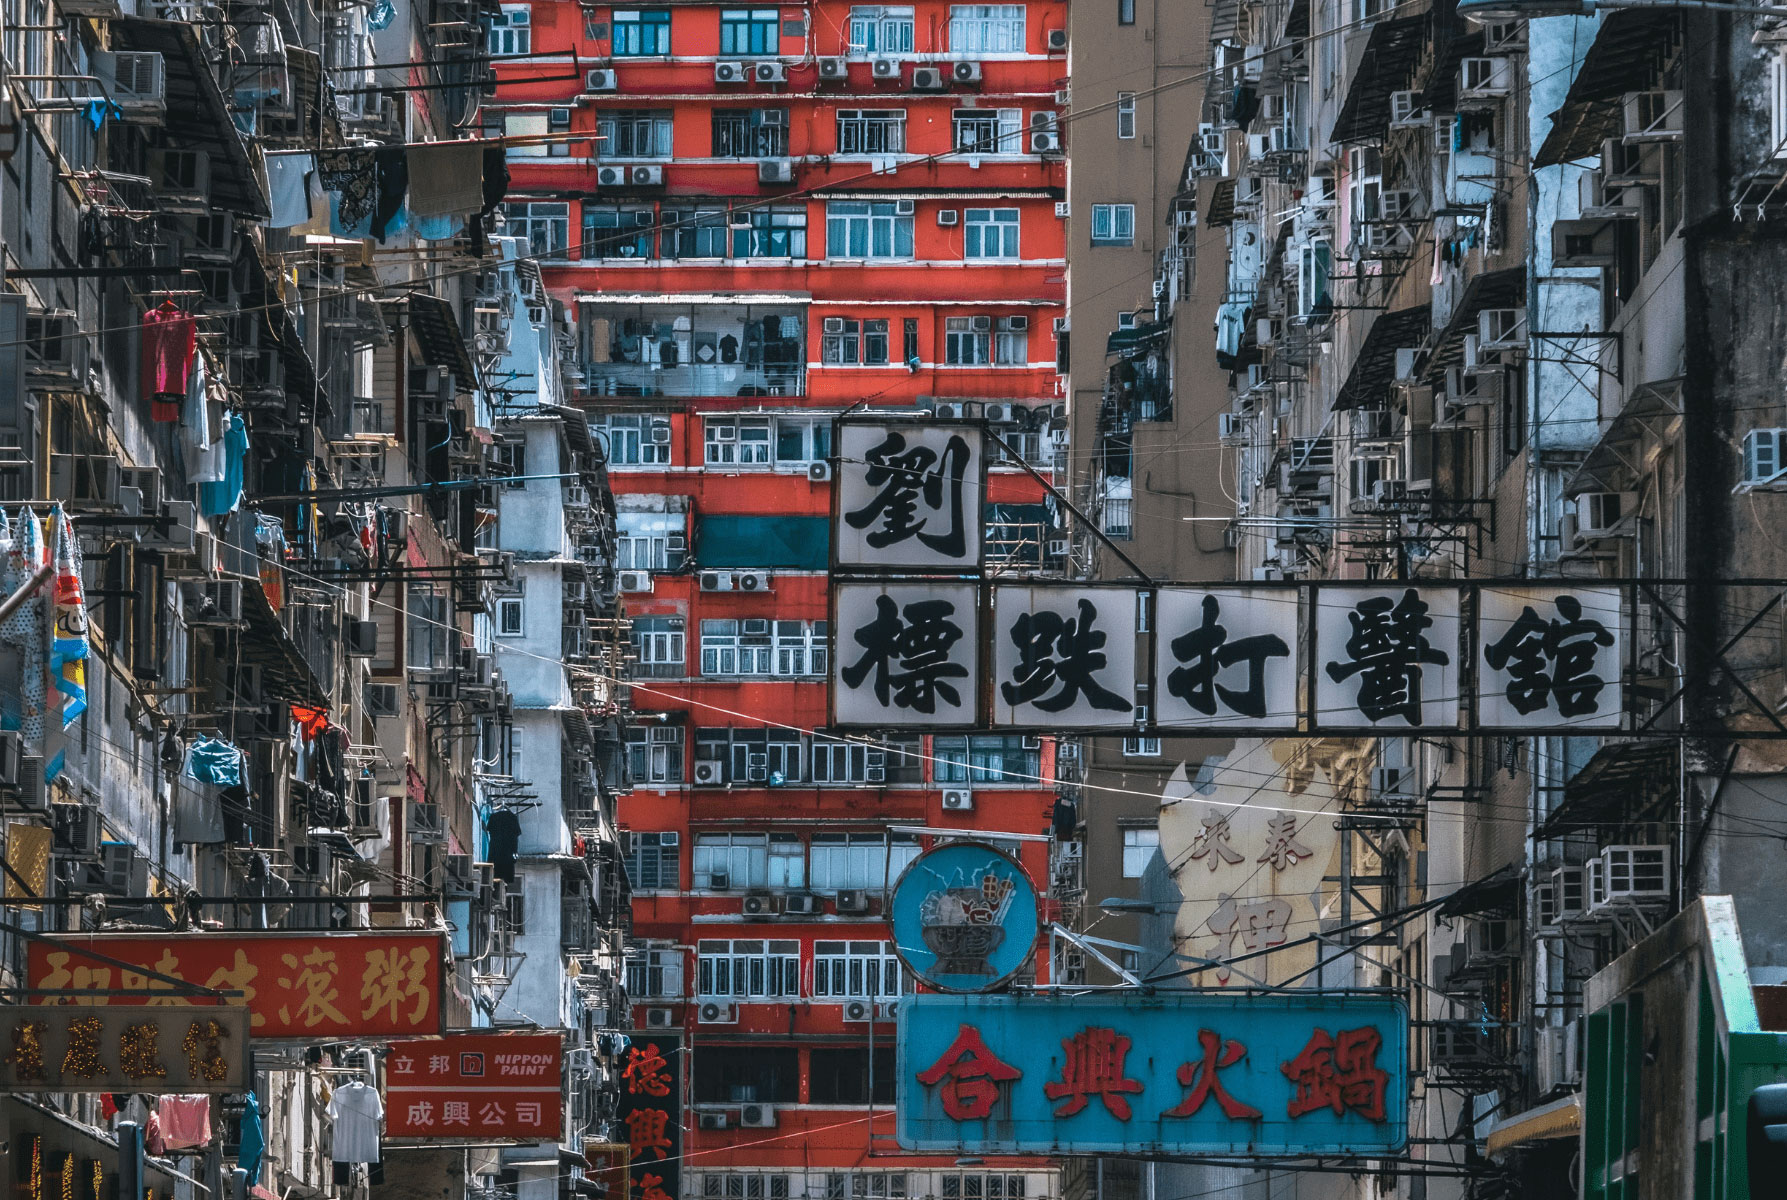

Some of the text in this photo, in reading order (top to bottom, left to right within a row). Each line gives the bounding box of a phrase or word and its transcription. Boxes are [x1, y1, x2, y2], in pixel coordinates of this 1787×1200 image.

[844, 430, 971, 558] 劉
[394, 1055, 450, 1074] 立邦
[494, 1054, 553, 1065] NIPPON
[500, 1065, 547, 1075] PAINT
[916, 1024, 1390, 1123] 合興火鍋
[406, 1100, 542, 1127] 成興公司
